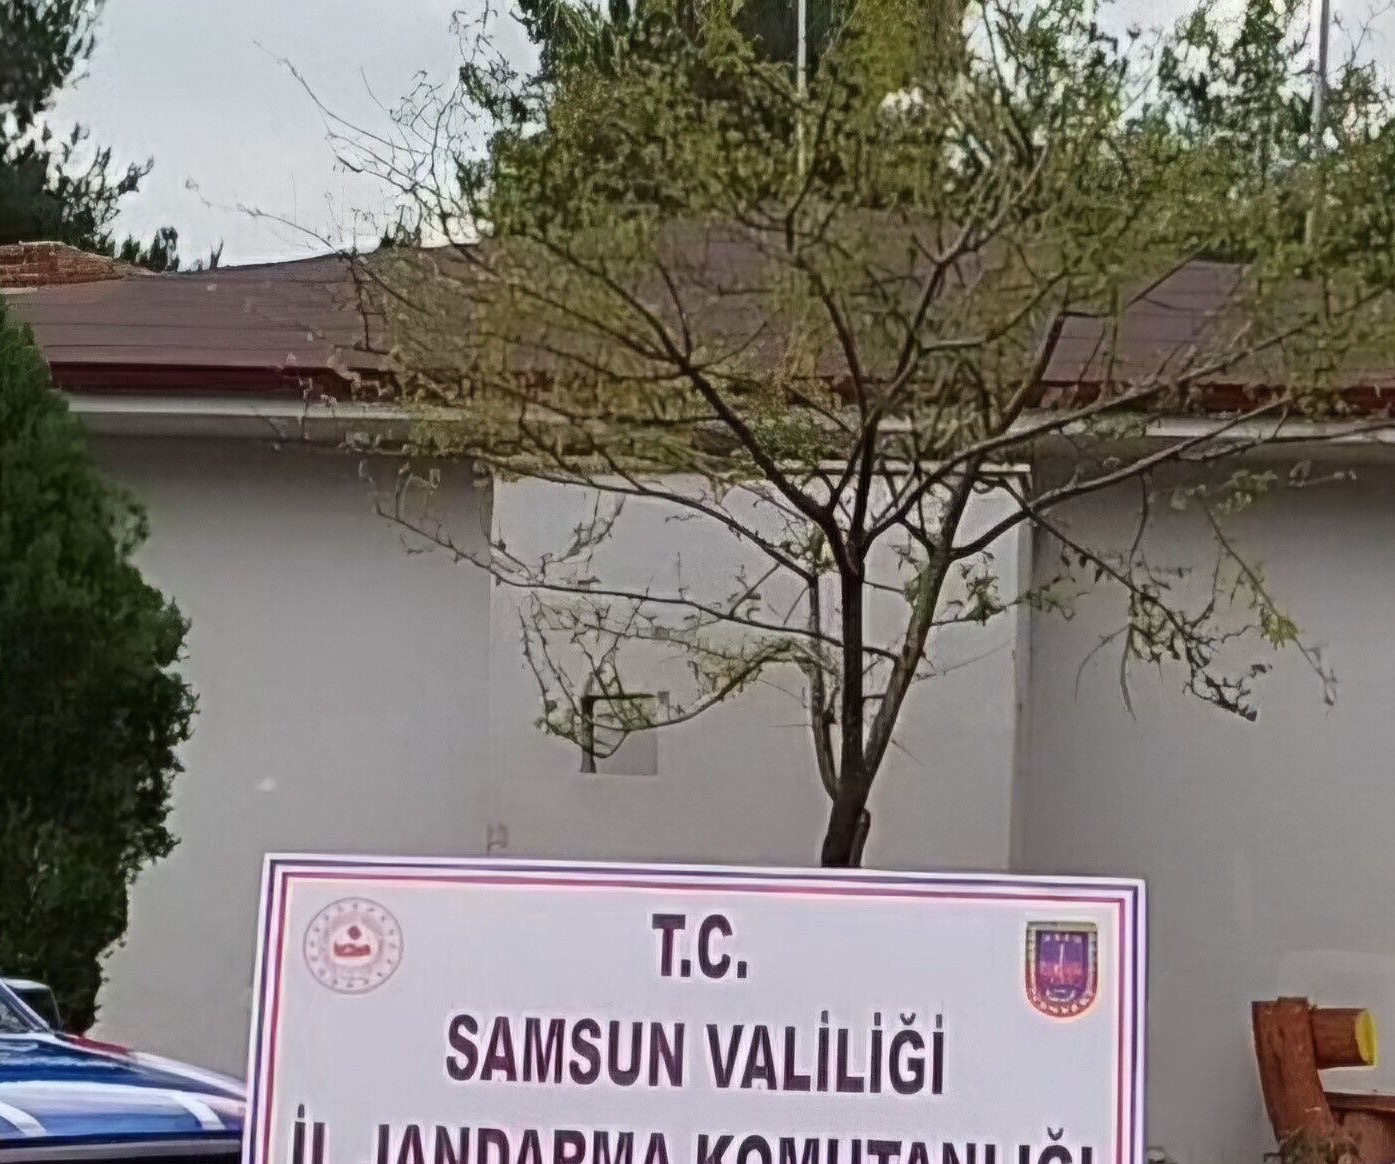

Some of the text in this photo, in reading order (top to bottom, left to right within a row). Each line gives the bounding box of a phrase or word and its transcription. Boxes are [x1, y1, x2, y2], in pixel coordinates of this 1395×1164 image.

[652, 914, 747, 979] T.C.
[446, 1010, 944, 1095] SAMSUN VALİLİĞİ
